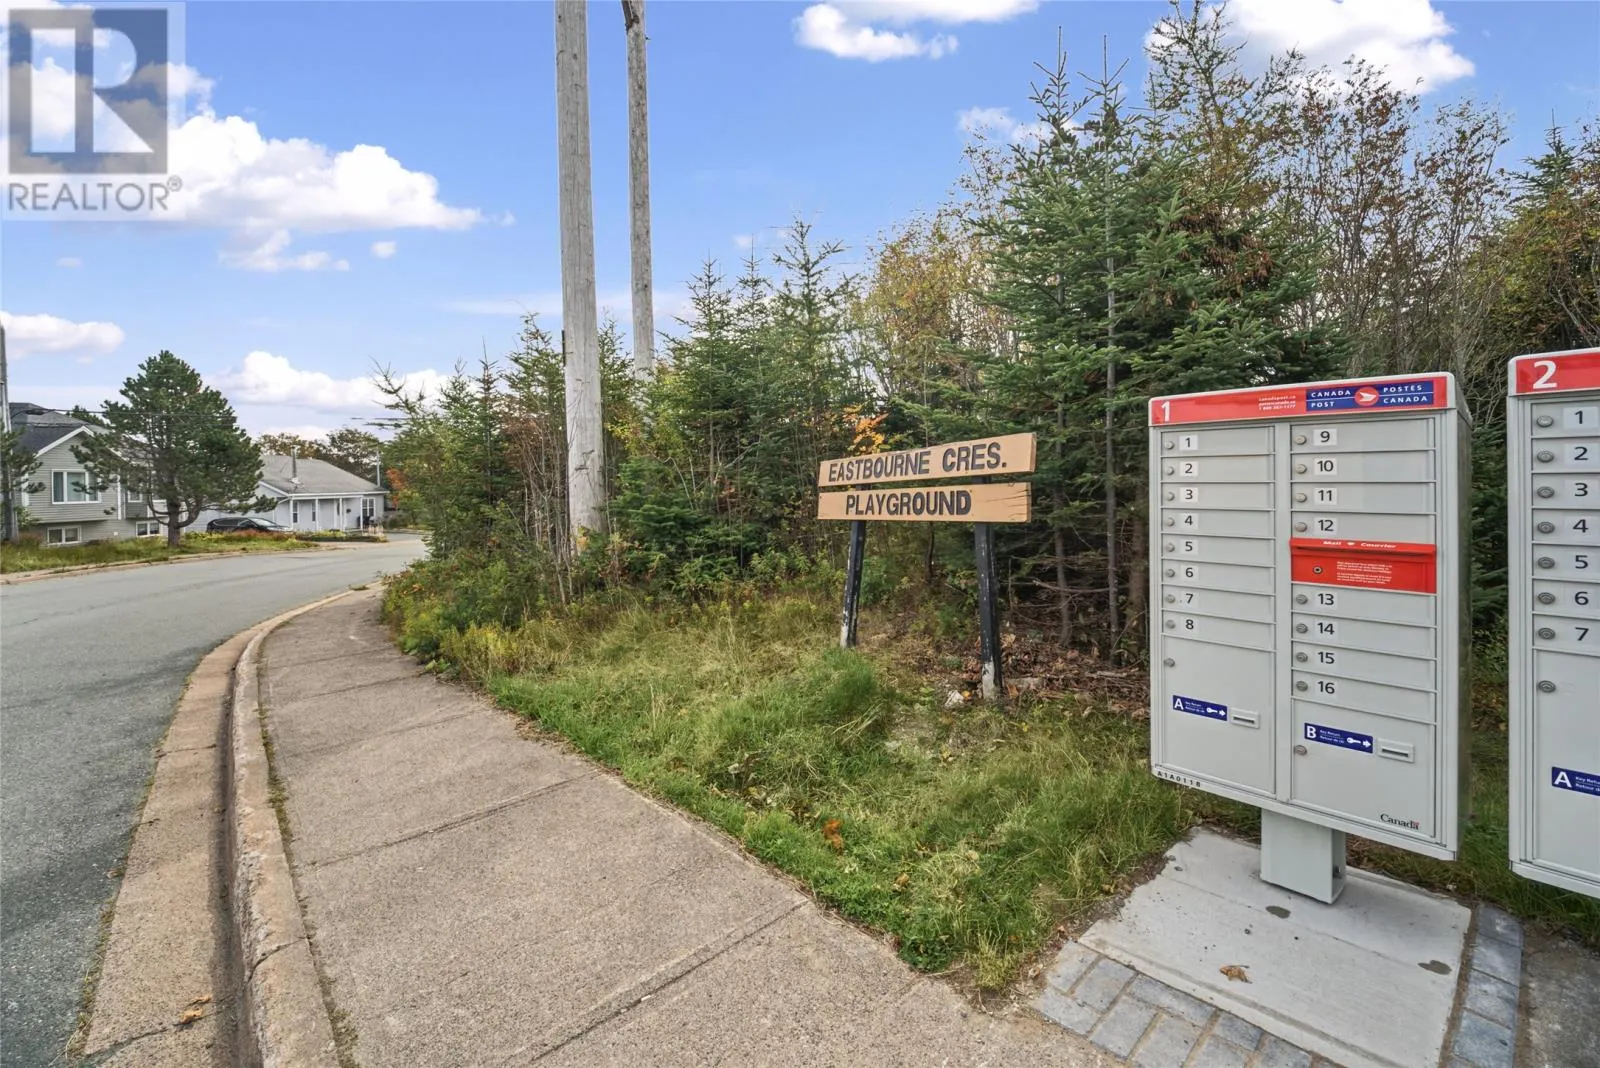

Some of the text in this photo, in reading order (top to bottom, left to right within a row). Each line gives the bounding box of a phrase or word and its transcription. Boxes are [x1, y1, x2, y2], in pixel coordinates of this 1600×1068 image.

[1532, 360, 1558, 389] 2
[1311, 390, 1351, 398] CANADA
[1383, 384, 1422, 393] POSTES
[1383, 395, 1428, 404] CANADA
[1160, 400, 1171, 422] 1
[1575, 410, 1584, 424] 1
[1185, 437, 1191, 448] 1
[1320, 430, 1330, 443] 9
[1573, 446, 1588, 461] 2
[828, 441, 1007, 482] EASTBOURNE CRES.
[1317, 460, 1334, 472] 10
[1185, 463, 1193, 474] 2
[1185, 489, 1193, 500] 3
[1318, 490, 1332, 501] 11
[1574, 482, 1588, 497] 3
[845, 489, 972, 516] PLAYGROUND
[1184, 515, 1193, 526] 4
[1318, 519, 1334, 532] 12
[1572, 518, 1589, 533] 4
[1185, 541, 1193, 552] 5
[1574, 555, 1589, 569] 5
[1185, 567, 1194, 578] 6
[1185, 593, 1194, 604] 7
[1318, 593, 1334, 605] 13
[1574, 591, 1589, 606] 6
[1185, 619, 1194, 630] 8
[1317, 622, 1335, 635] 14
[1574, 627, 1589, 642] 7
[1318, 651, 1335, 664] 15
[1317, 681, 1335, 694] 16
[1174, 698, 1184, 710] A
[1306, 725, 1317, 739] B
[1554, 771, 1572, 788] A
[1380, 813, 1419, 830] Canada
